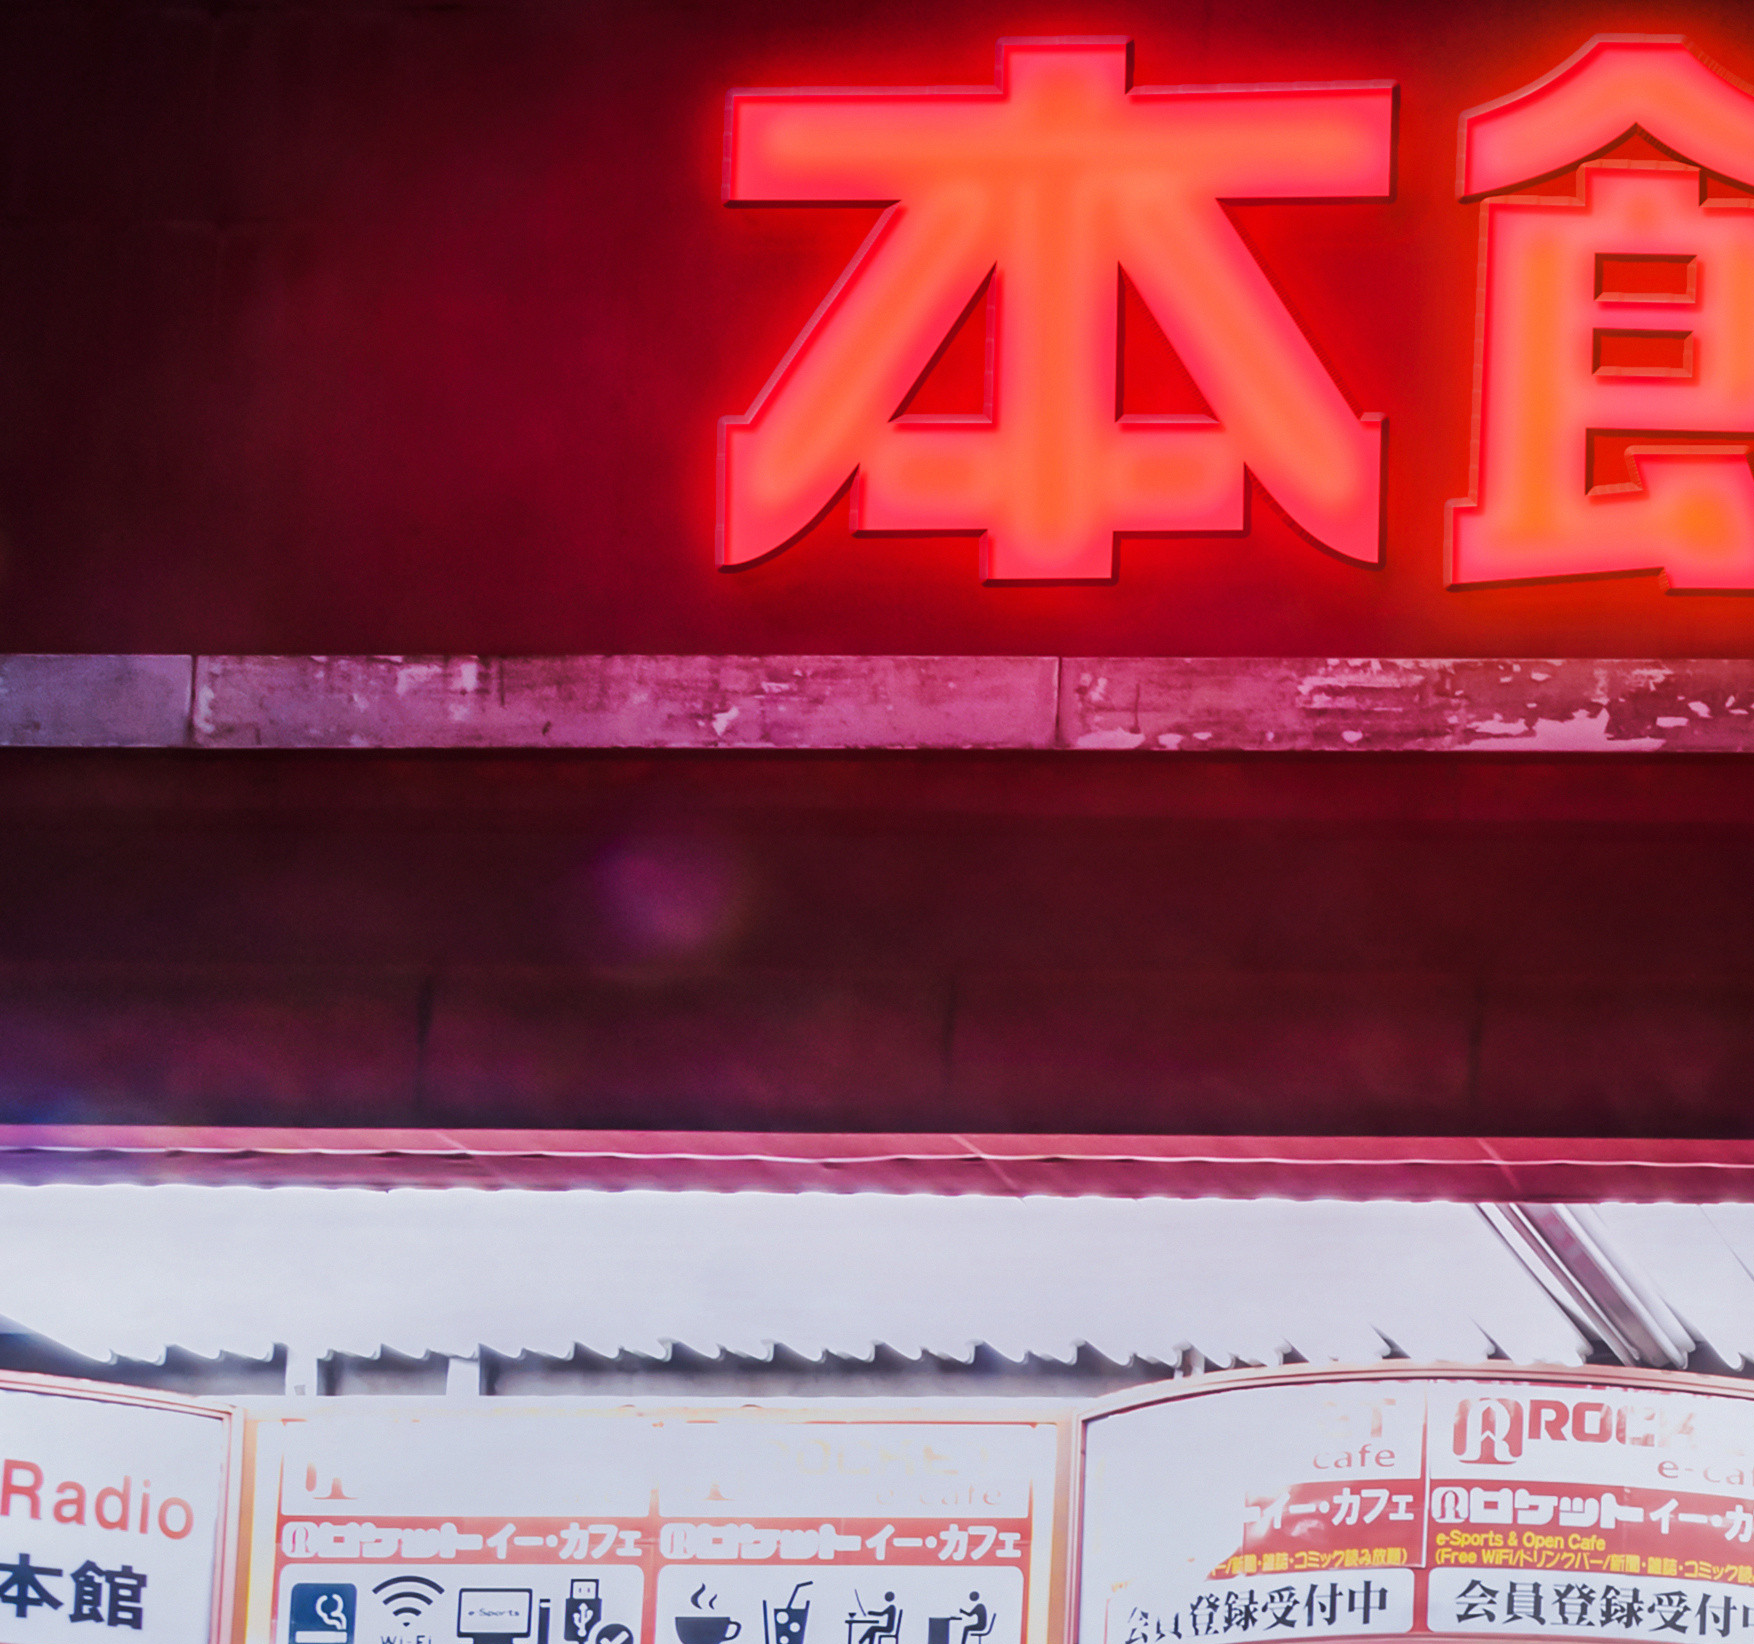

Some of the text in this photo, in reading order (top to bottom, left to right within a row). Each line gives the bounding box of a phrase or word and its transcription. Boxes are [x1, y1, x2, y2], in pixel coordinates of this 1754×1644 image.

[2, 1458, 194, 1541] Radio
[1436, 1531, 1606, 1554] e-Sports & Open Cafe
[0, 1552, 147, 1629] 本館
